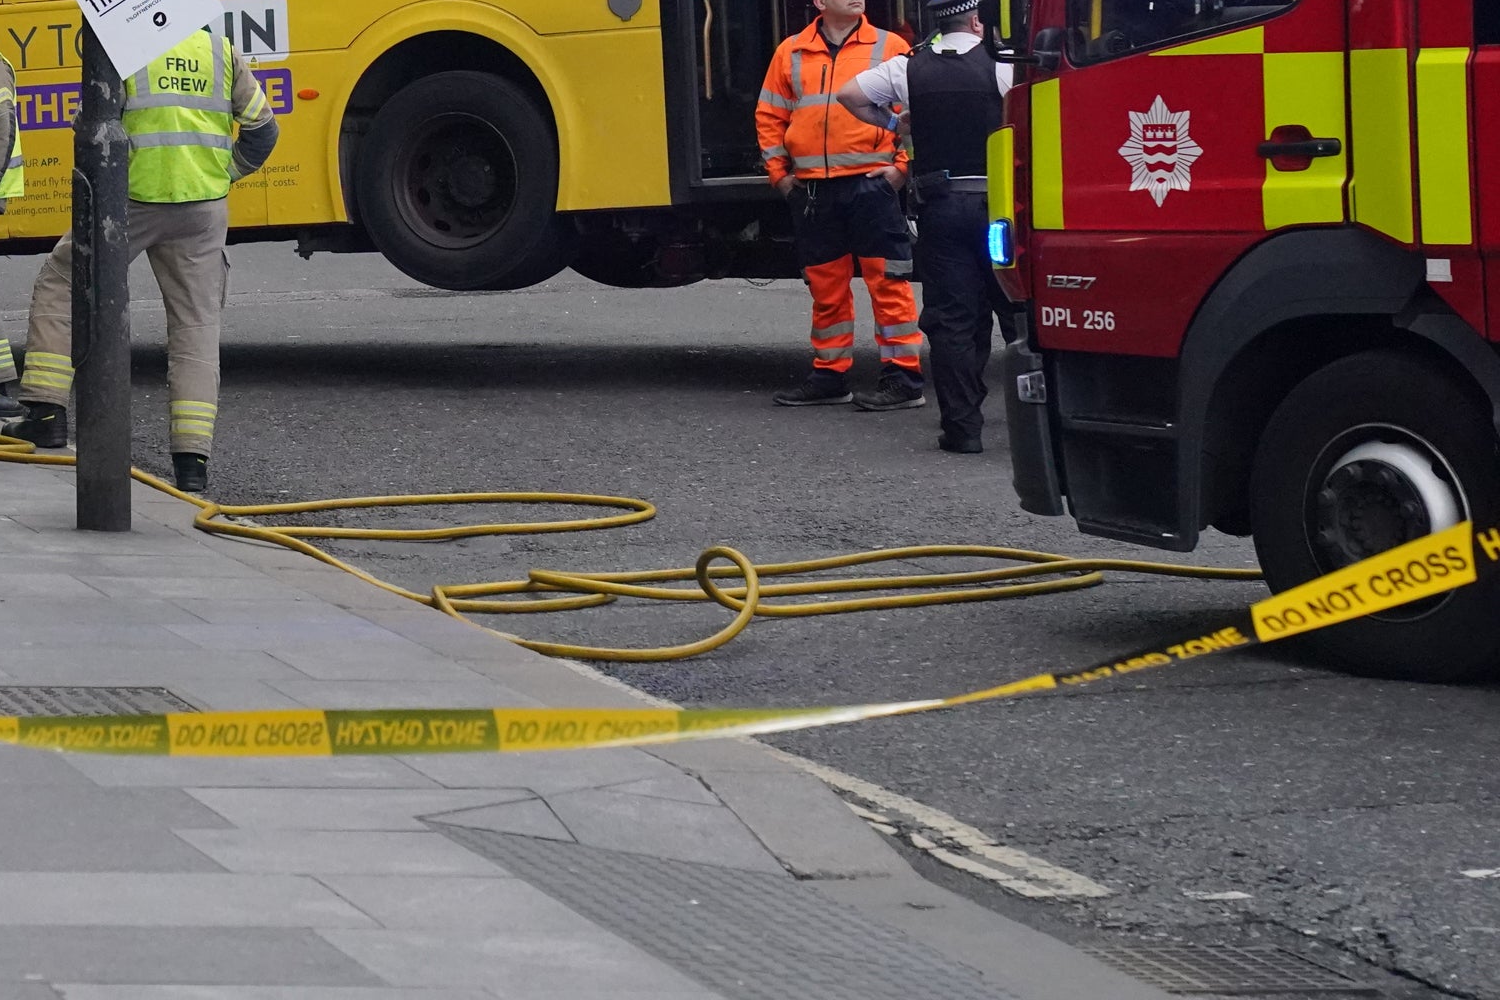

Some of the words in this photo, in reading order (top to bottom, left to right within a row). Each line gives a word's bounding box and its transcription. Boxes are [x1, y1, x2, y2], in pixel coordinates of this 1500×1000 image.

[165, 57, 199, 74] FRU
[158, 76, 208, 93] CREW
[261, 163, 300, 176] operated
[32, 179, 47, 188] and
[1046, 275, 1097, 290] 1327
[1042, 306, 1078, 329] DPL
[1082, 310, 1116, 332] 256
[1261, 610, 1304, 634] DO
[1306, 583, 1366, 619] NOT
[1369, 546, 1468, 598] CROSS
[1172, 626, 1250, 659] ZONE
